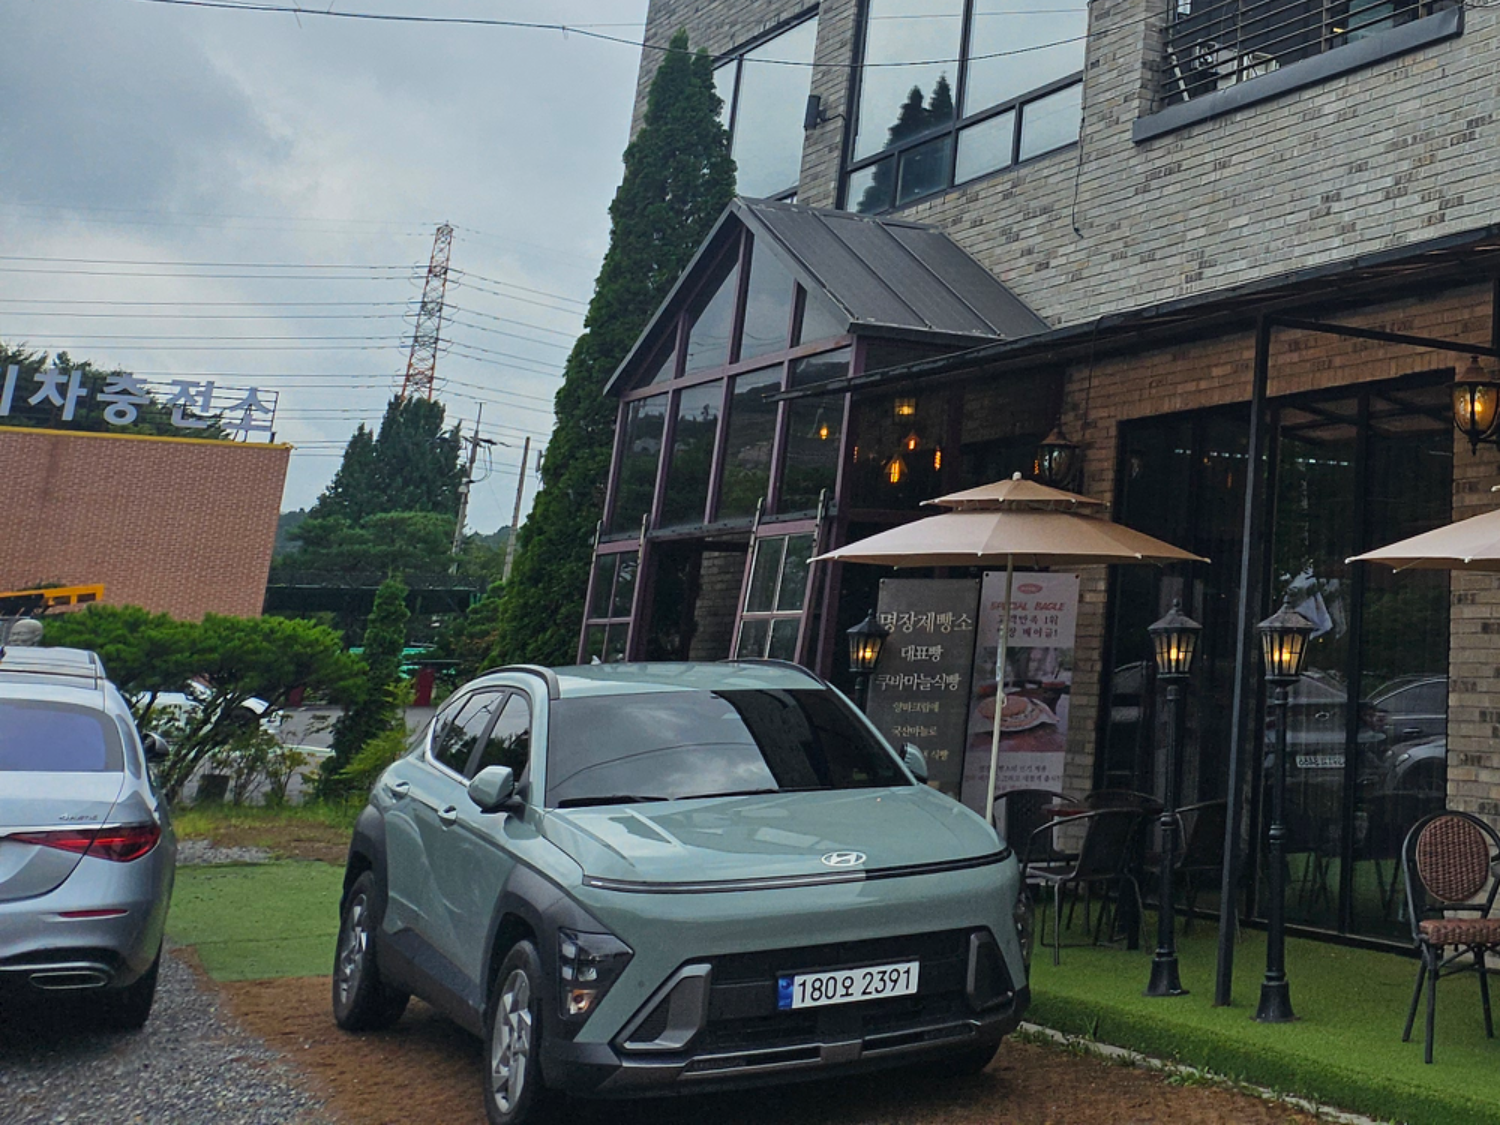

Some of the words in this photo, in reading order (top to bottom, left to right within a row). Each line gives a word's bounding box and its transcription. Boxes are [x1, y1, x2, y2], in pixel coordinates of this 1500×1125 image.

[1034, 600, 1067, 611] BAGLE
[879, 610, 973, 634] 명장제빵소
[900, 644, 944, 663] 대표빵
[876, 672, 962, 691] 쿠바마늘식빵
[797, 975, 855, 1004] 180오
[861, 966, 912, 997] 2391
